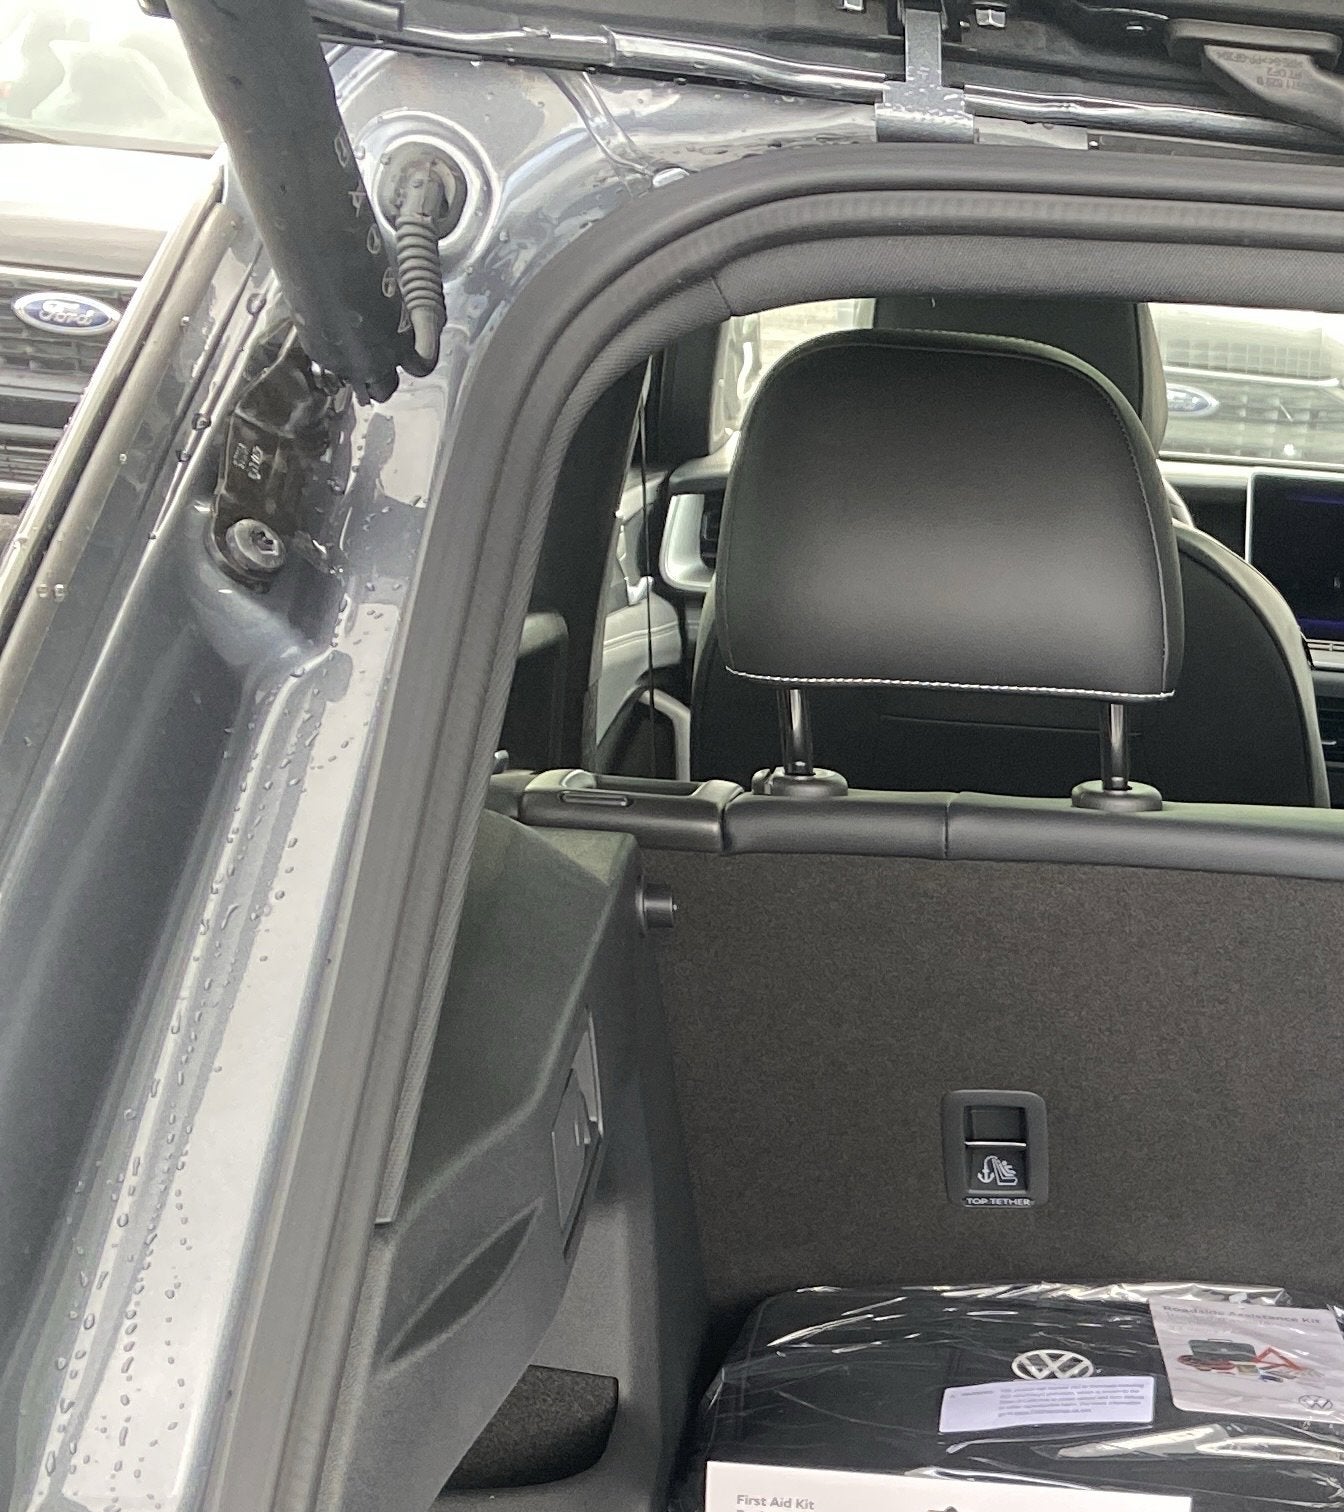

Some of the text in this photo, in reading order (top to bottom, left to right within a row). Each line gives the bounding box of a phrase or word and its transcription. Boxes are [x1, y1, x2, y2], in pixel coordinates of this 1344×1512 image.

[966, 1197, 1031, 1206] TOP TETHER
[736, 1494, 815, 1510] First Aid Kit
